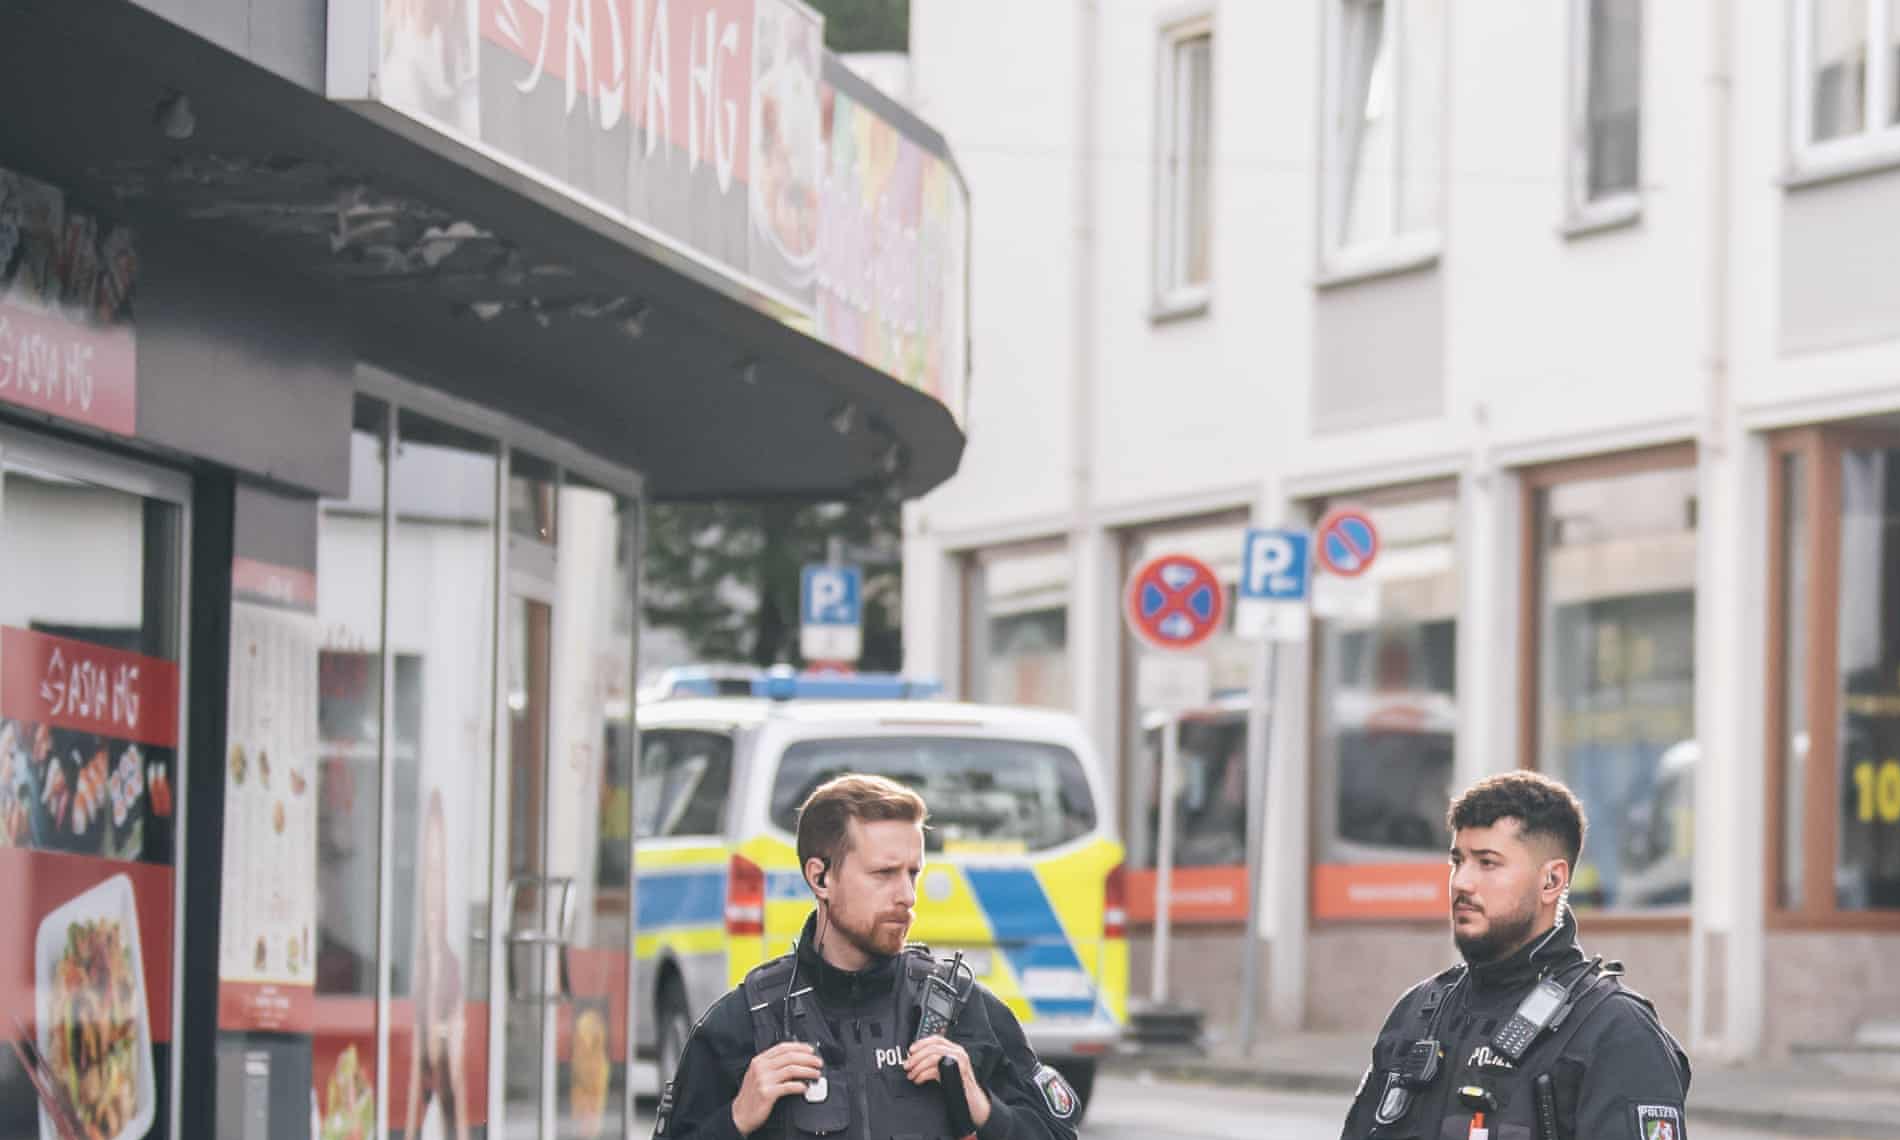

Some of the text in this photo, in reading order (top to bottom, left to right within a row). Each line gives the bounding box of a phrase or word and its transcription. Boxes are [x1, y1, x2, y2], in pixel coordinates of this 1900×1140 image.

[688, 8, 739, 196] HG
[68, 660, 140, 730] ASIA HG
